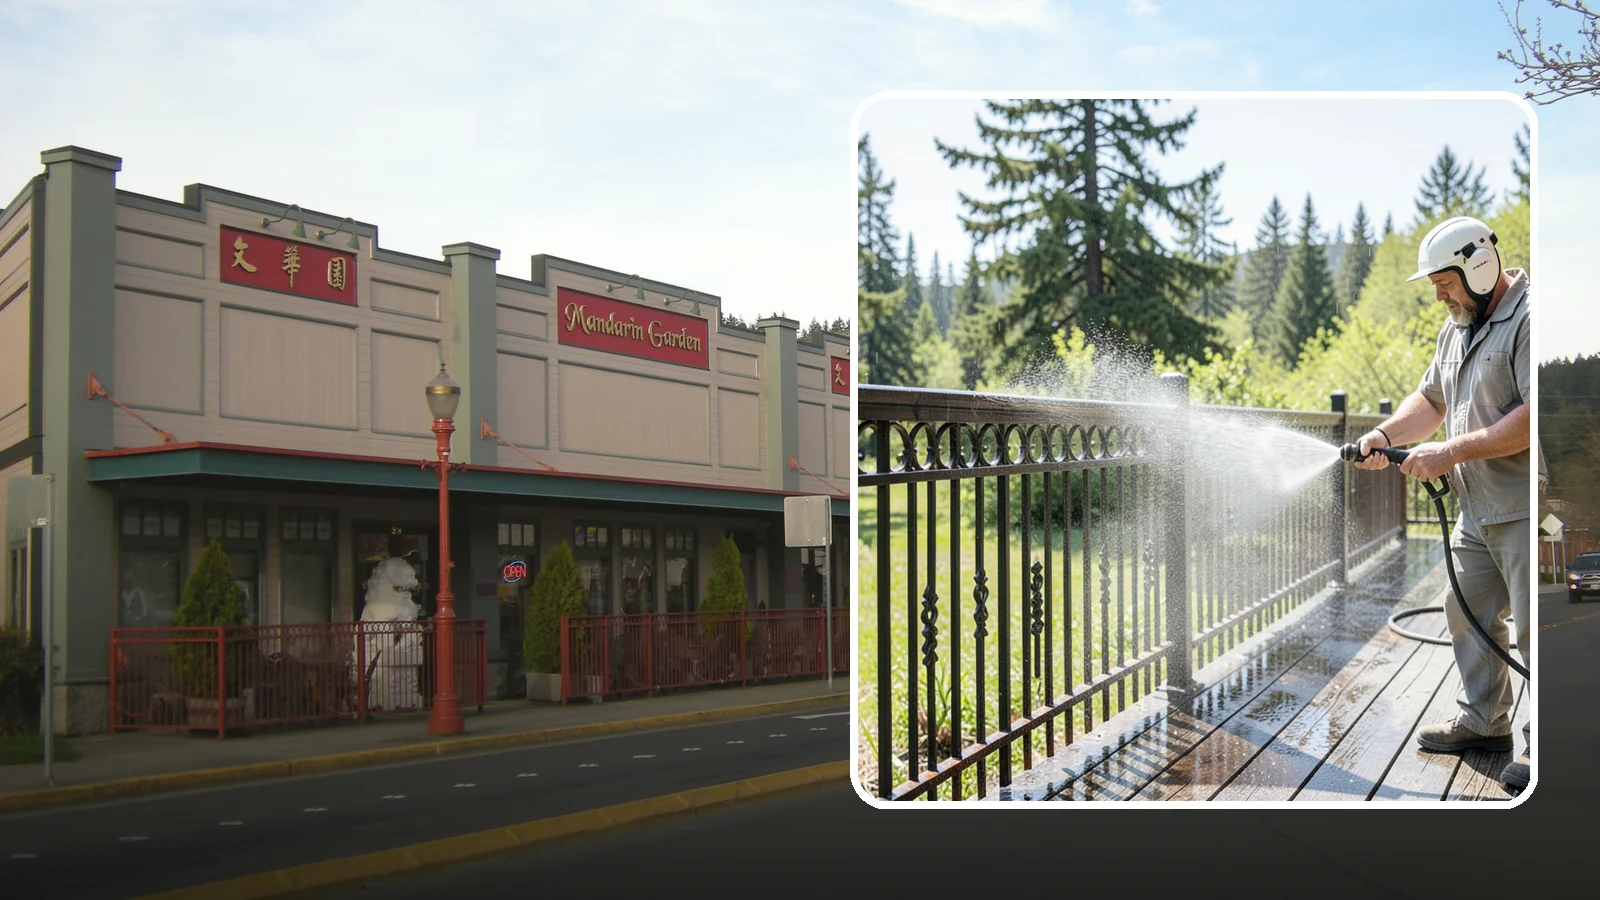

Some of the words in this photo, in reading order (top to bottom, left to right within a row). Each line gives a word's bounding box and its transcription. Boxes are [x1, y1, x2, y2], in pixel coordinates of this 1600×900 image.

[230, 235, 346, 291] 文華園
[564, 302, 644, 340] Mandarin
[648, 320, 701, 352] Garden
[503, 565, 527, 578] OPEN
